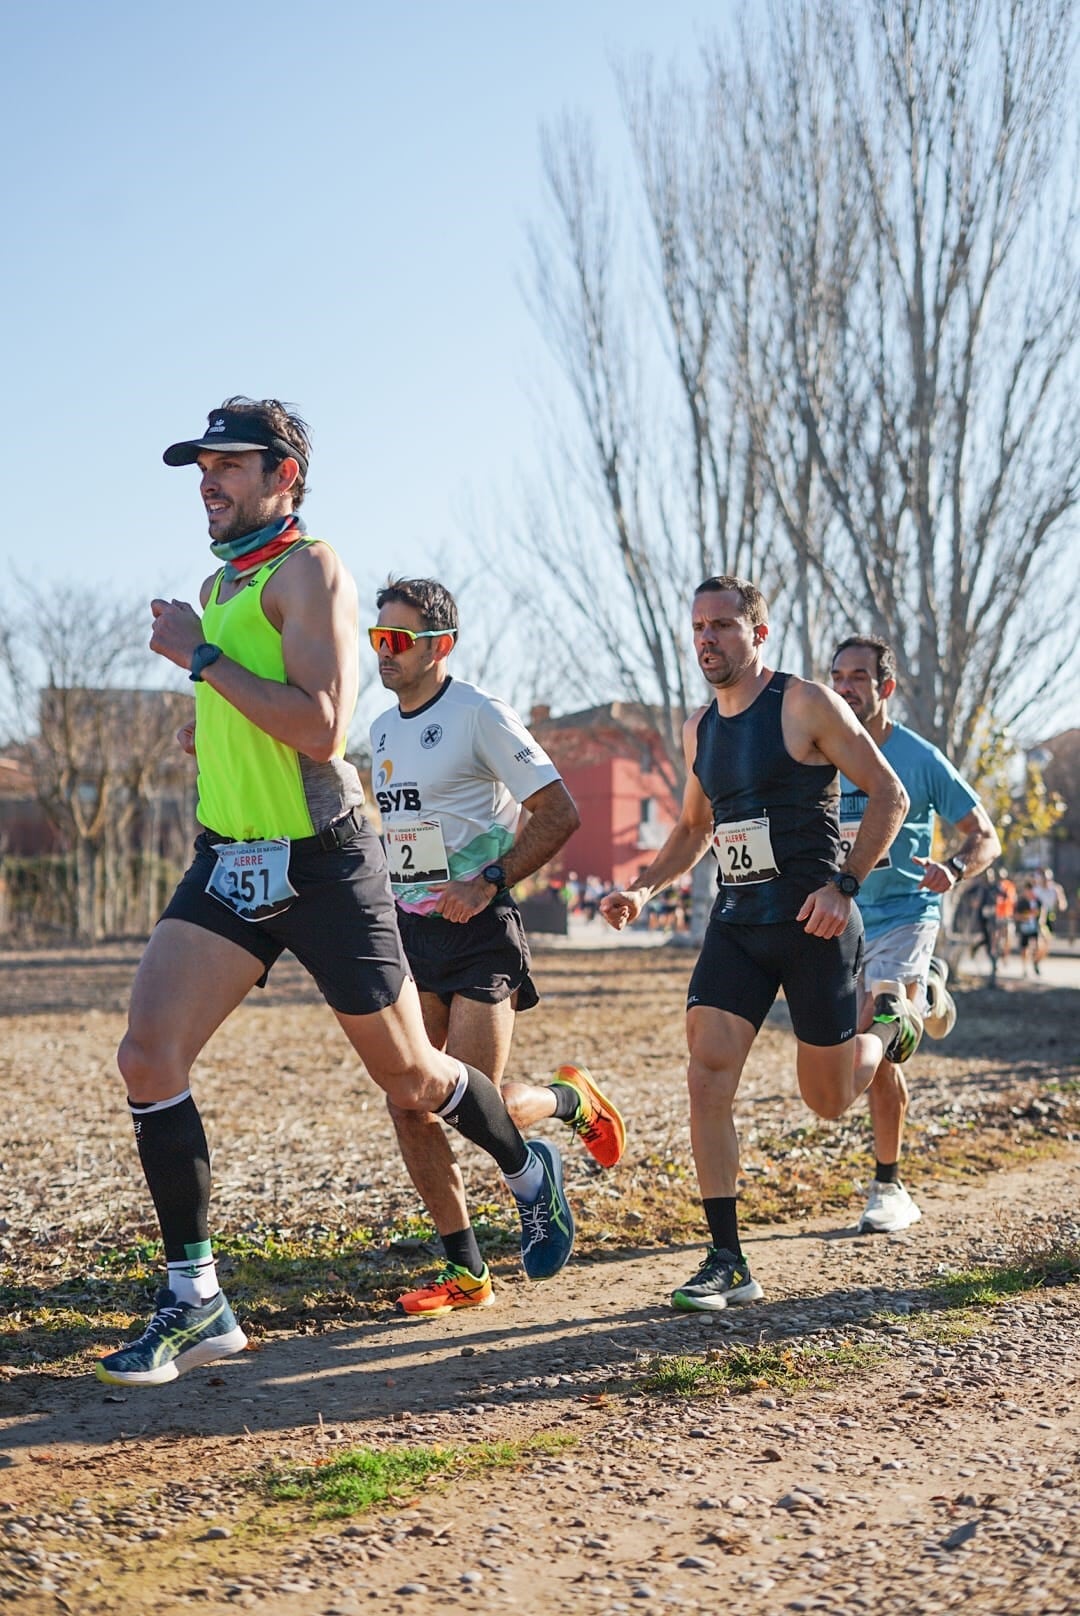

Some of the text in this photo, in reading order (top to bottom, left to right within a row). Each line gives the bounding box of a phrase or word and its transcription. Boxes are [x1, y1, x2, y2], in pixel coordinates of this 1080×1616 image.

[375, 788, 422, 814] SYB
[394, 832, 417, 842] ALERRE
[725, 833, 748, 844] ALERRE
[234, 855, 263, 867] ALERRE
[400, 843, 416, 870] 2
[727, 844, 753, 871] 26
